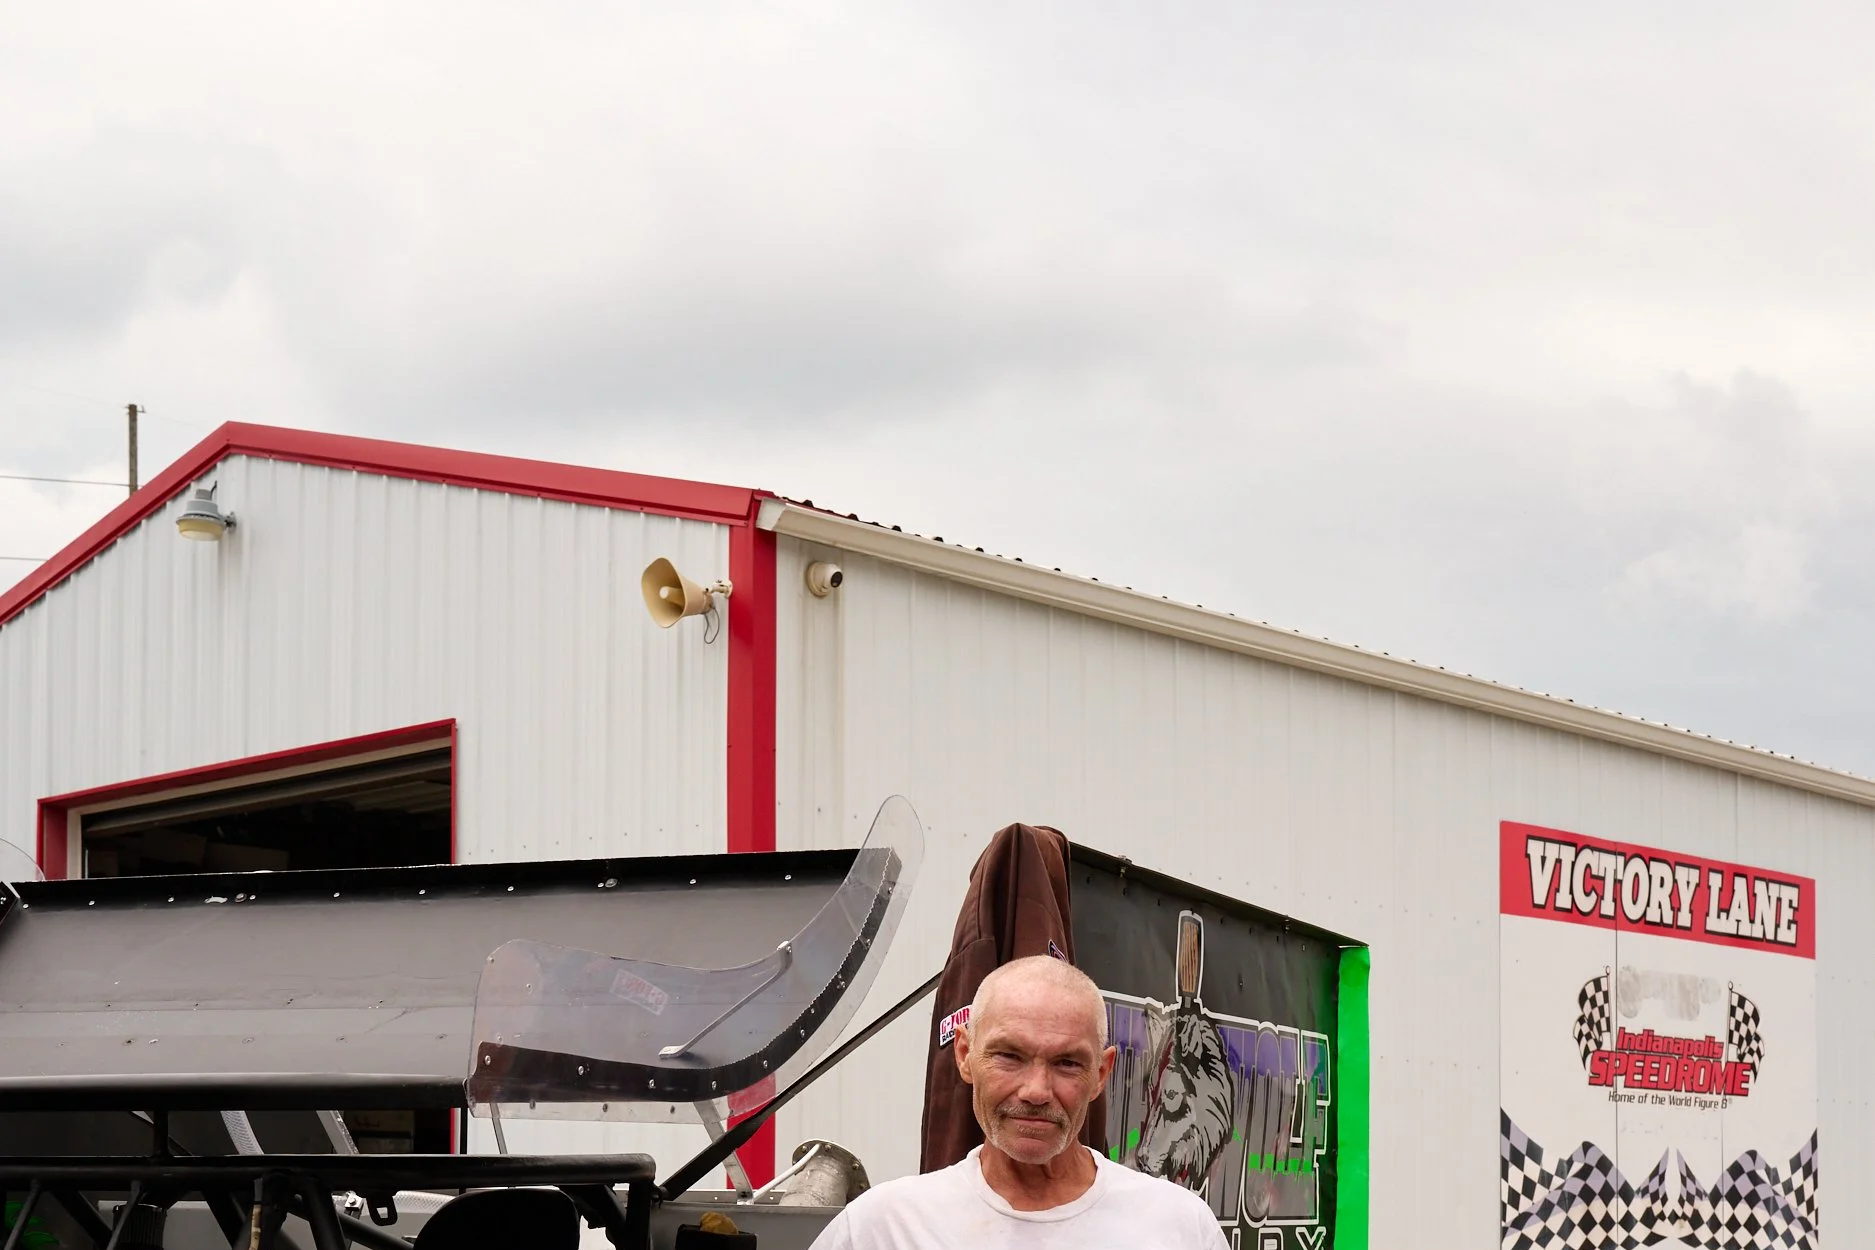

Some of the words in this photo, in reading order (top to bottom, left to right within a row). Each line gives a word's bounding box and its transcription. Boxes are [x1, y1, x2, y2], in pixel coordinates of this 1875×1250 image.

[1525, 835, 1701, 931] VICTORY
[1705, 868, 1800, 947] LANE
[1616, 1027, 1724, 1060] Indianapolis
[1588, 1050, 1752, 1096] SPEEDROME
[1609, 1091, 1634, 1103] Home
[1638, 1093, 1648, 1104] of
[1651, 1093, 1666, 1106] the
[1668, 1095, 1691, 1107] World
[1694, 1097, 1719, 1110] Figure
